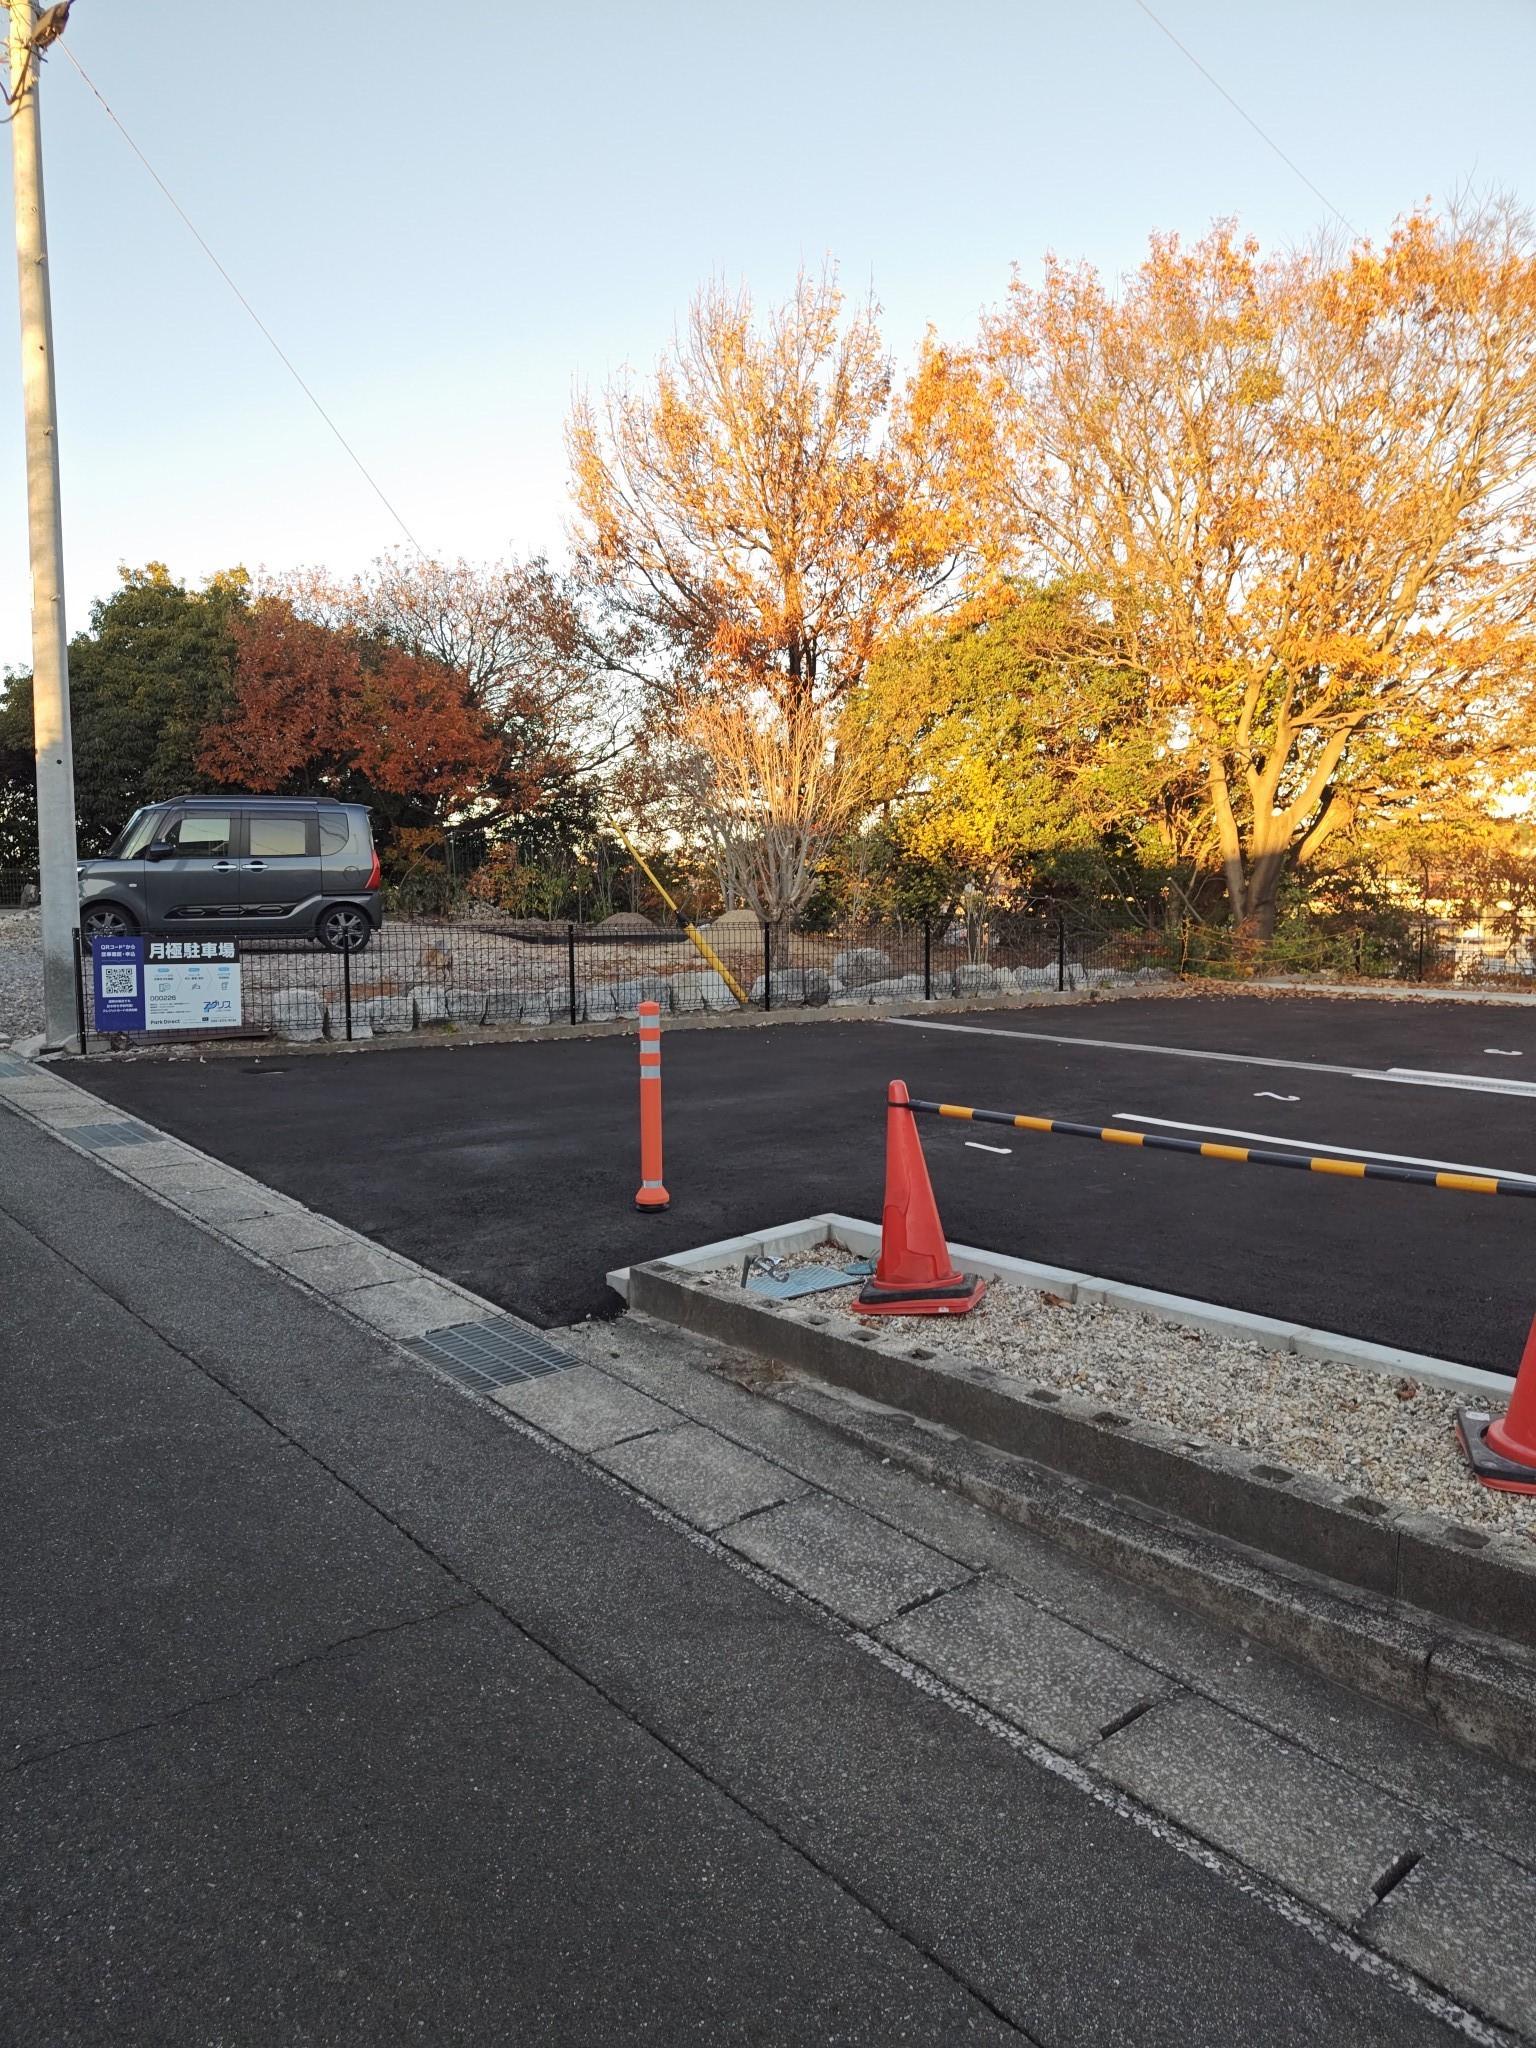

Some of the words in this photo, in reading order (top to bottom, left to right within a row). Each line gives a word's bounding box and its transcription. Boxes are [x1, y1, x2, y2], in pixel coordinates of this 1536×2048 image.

[149, 942, 235, 959] 月極駐車場
[1253, 1091, 1300, 1101] 2
